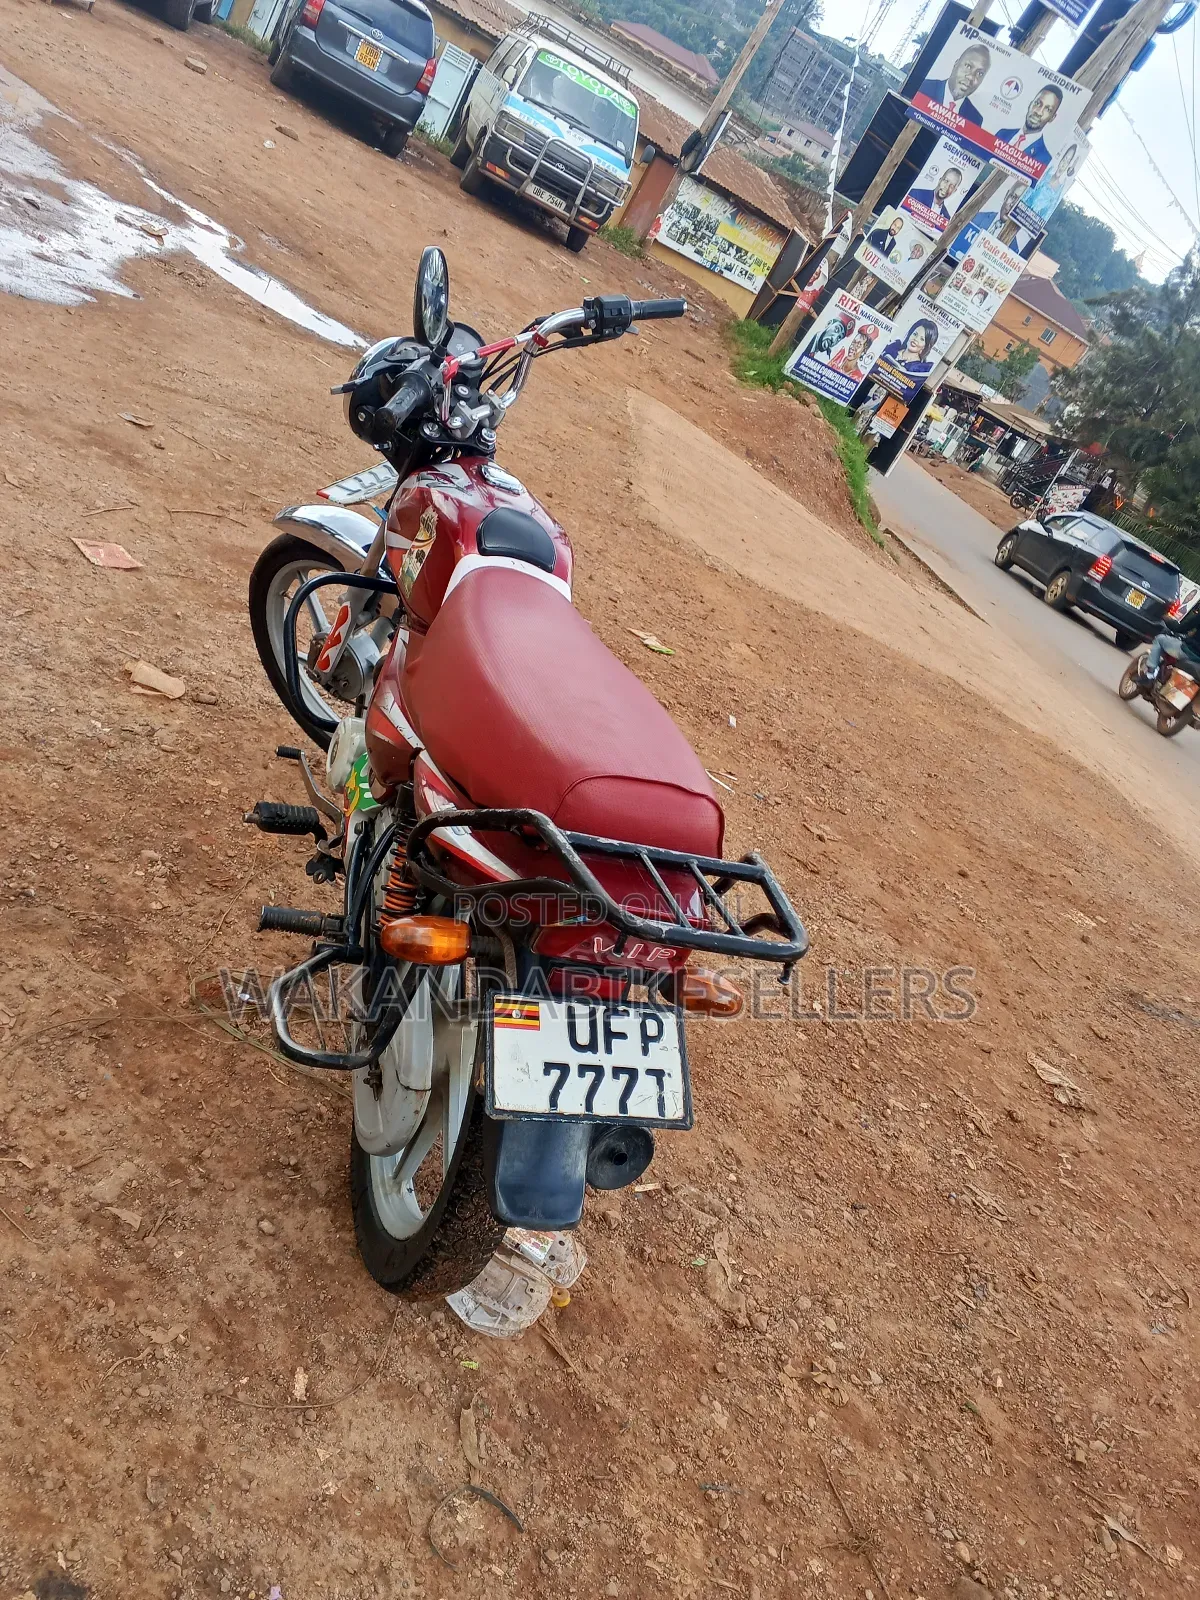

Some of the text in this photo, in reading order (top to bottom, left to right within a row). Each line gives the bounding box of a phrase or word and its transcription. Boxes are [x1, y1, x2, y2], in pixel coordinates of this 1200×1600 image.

[365, 45, 379, 60] UBB
[959, 24, 980, 41] MP
[995, 45, 1012, 58] NORTH
[556, 58, 622, 102] TOYOTA
[1037, 66, 1083, 96] PRESIDENT
[927, 100, 967, 128] KAWALYA
[942, 141, 981, 170] SSENYONGA
[993, 138, 1043, 171] KYAGULANYI
[532, 186, 546, 199] UBE
[861, 246, 881, 269] VOTE
[981, 251, 1013, 275] RESTAURANT
[982, 238, 1001, 258] Cafe
[999, 250, 1022, 273] Palais
[837, 294, 862, 315] RITA
[859, 309, 893, 333] NAKUBULWA
[916, 294, 940, 314] BUTAYI
[938, 308, 961, 329] HELLEN
[800, 356, 821, 372] WOMAN
[818, 364, 849, 386] COUNCILLOR
[594, 937, 677, 962] VIP
[567, 1004, 665, 1056] UFP
[543, 1061, 667, 1118] 777T
